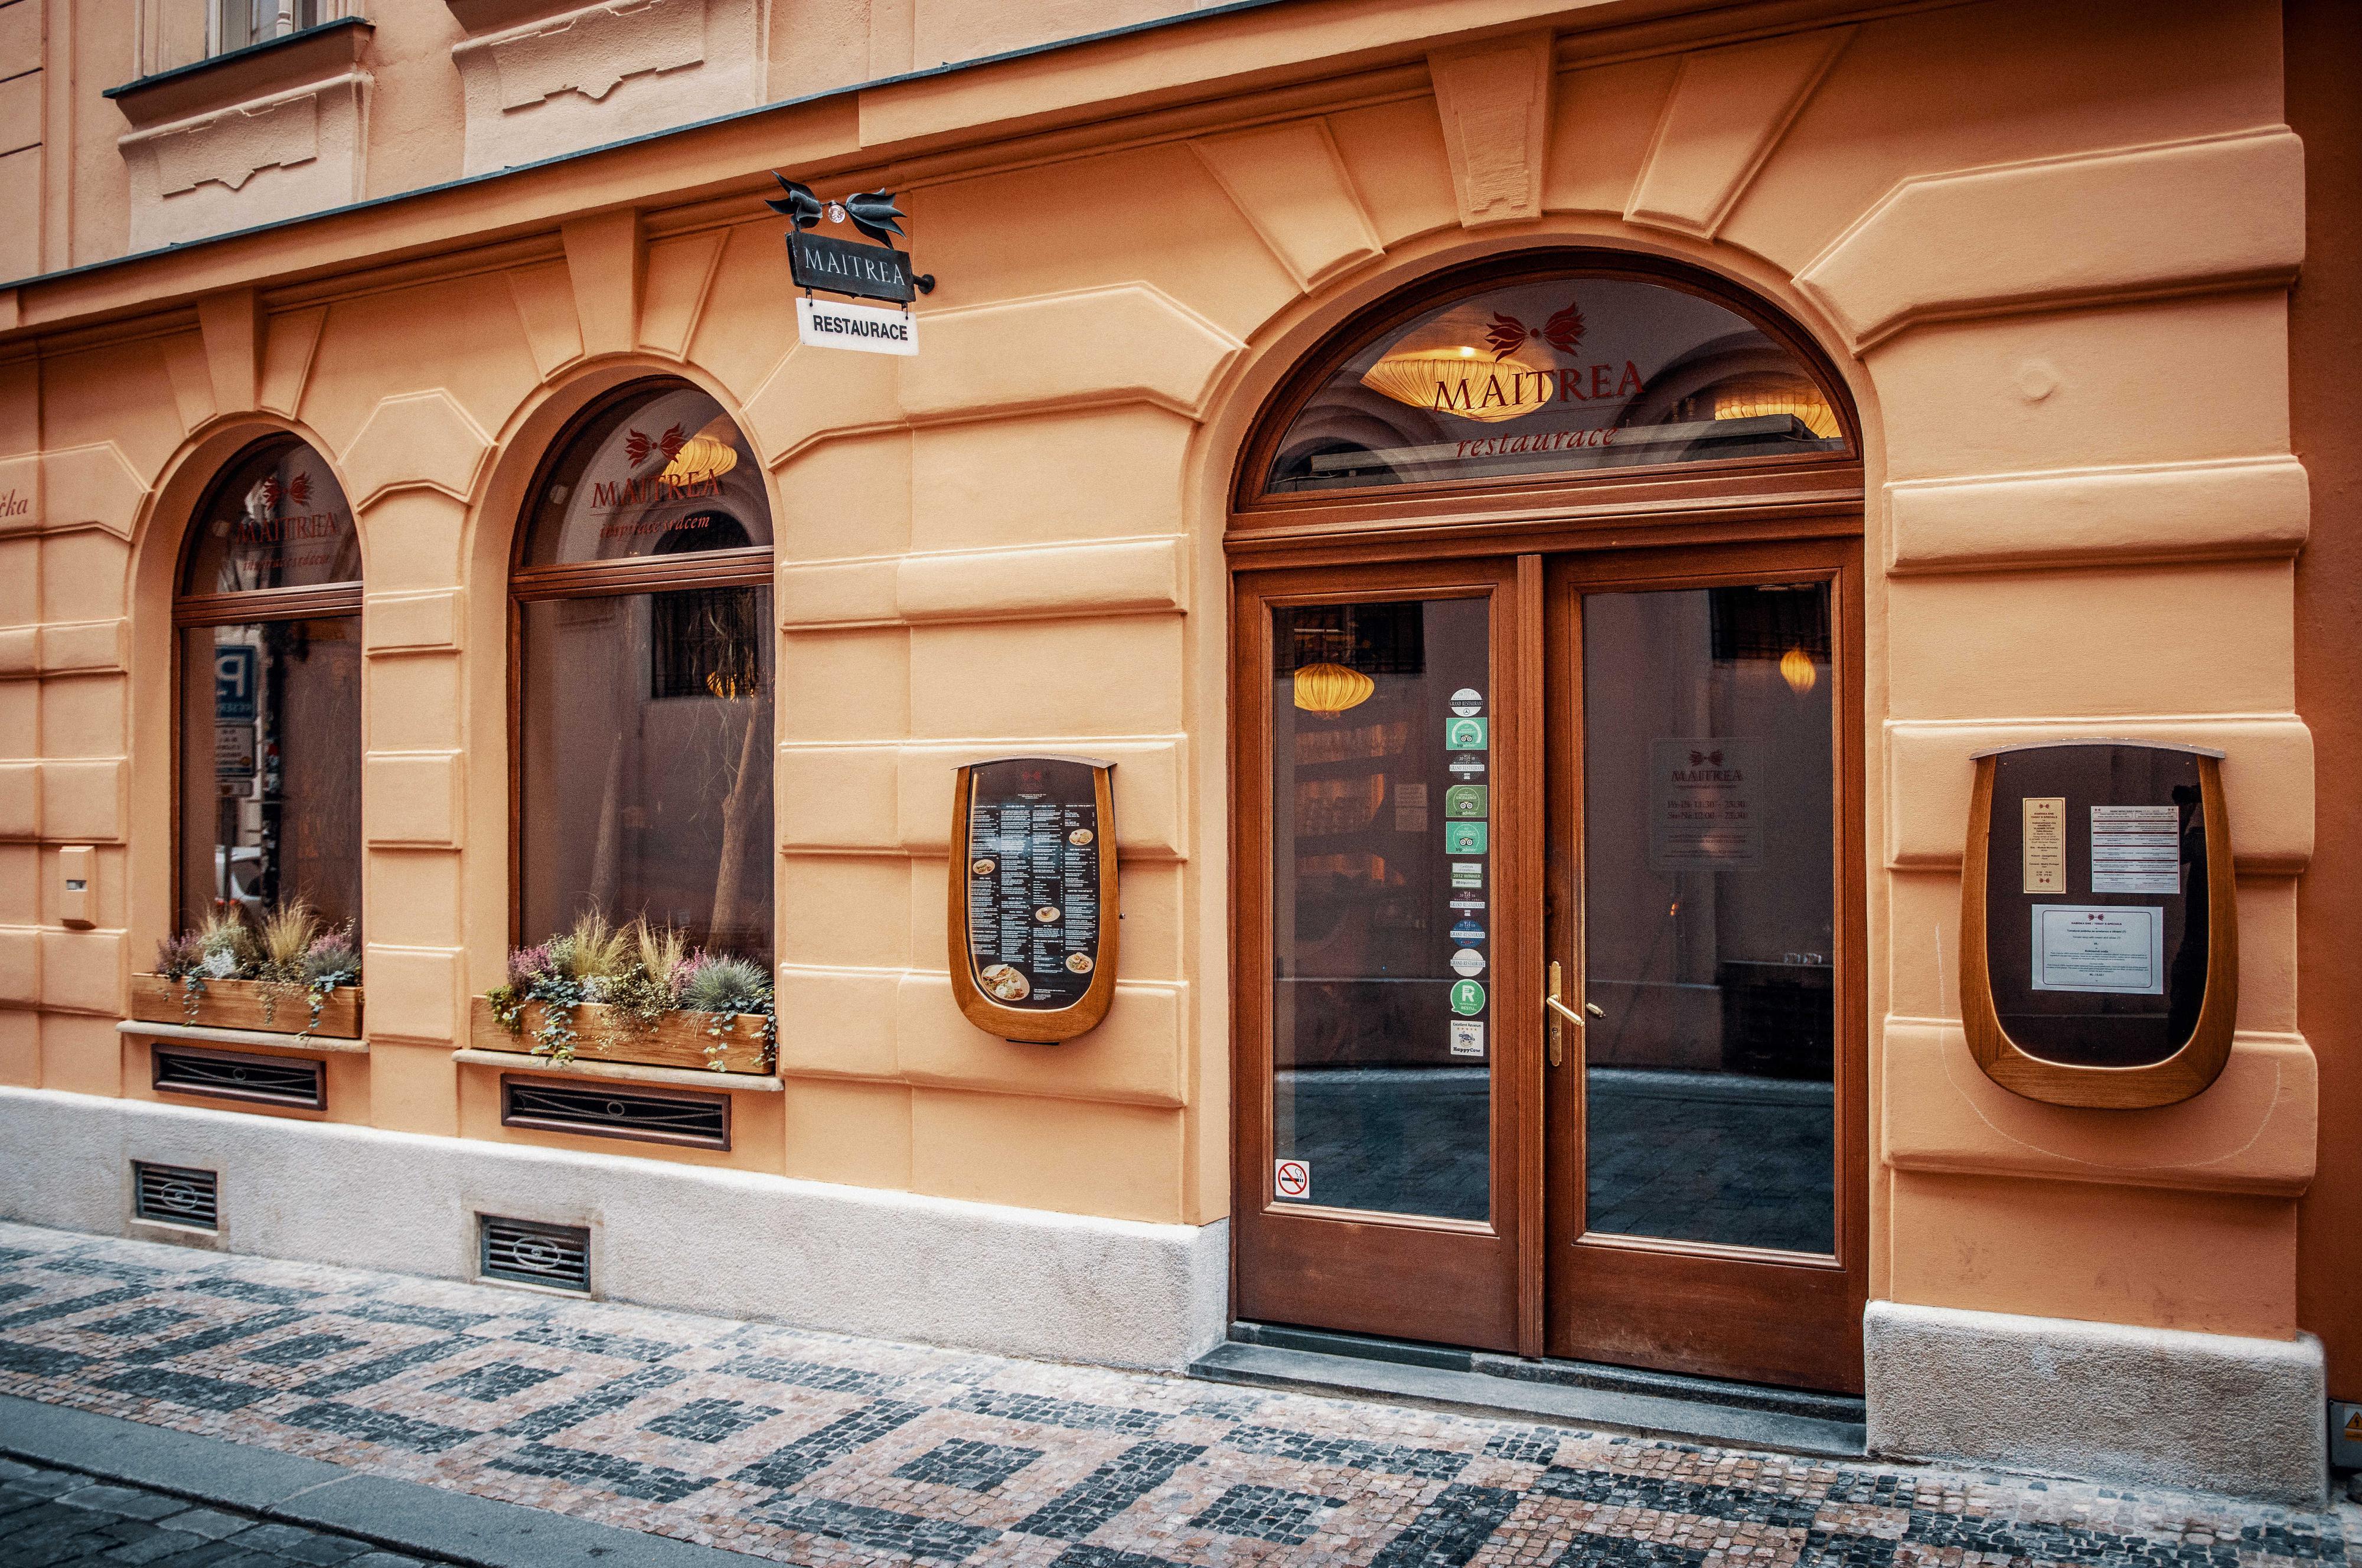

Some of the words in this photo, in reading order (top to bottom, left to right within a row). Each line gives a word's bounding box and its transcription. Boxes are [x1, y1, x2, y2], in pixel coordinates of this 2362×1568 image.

[804, 247, 905, 286] MAITREA
[813, 315, 908, 341] RESTAURACE
[1433, 360, 1645, 413] MAITREA
[1456, 426, 1619, 458] restaurace
[590, 468, 719, 508] MAITREA
[236, 512, 337, 545] MAITREA
[663, 514, 710, 532] srdcem
[1672, 770, 1743, 781] MAITREA
